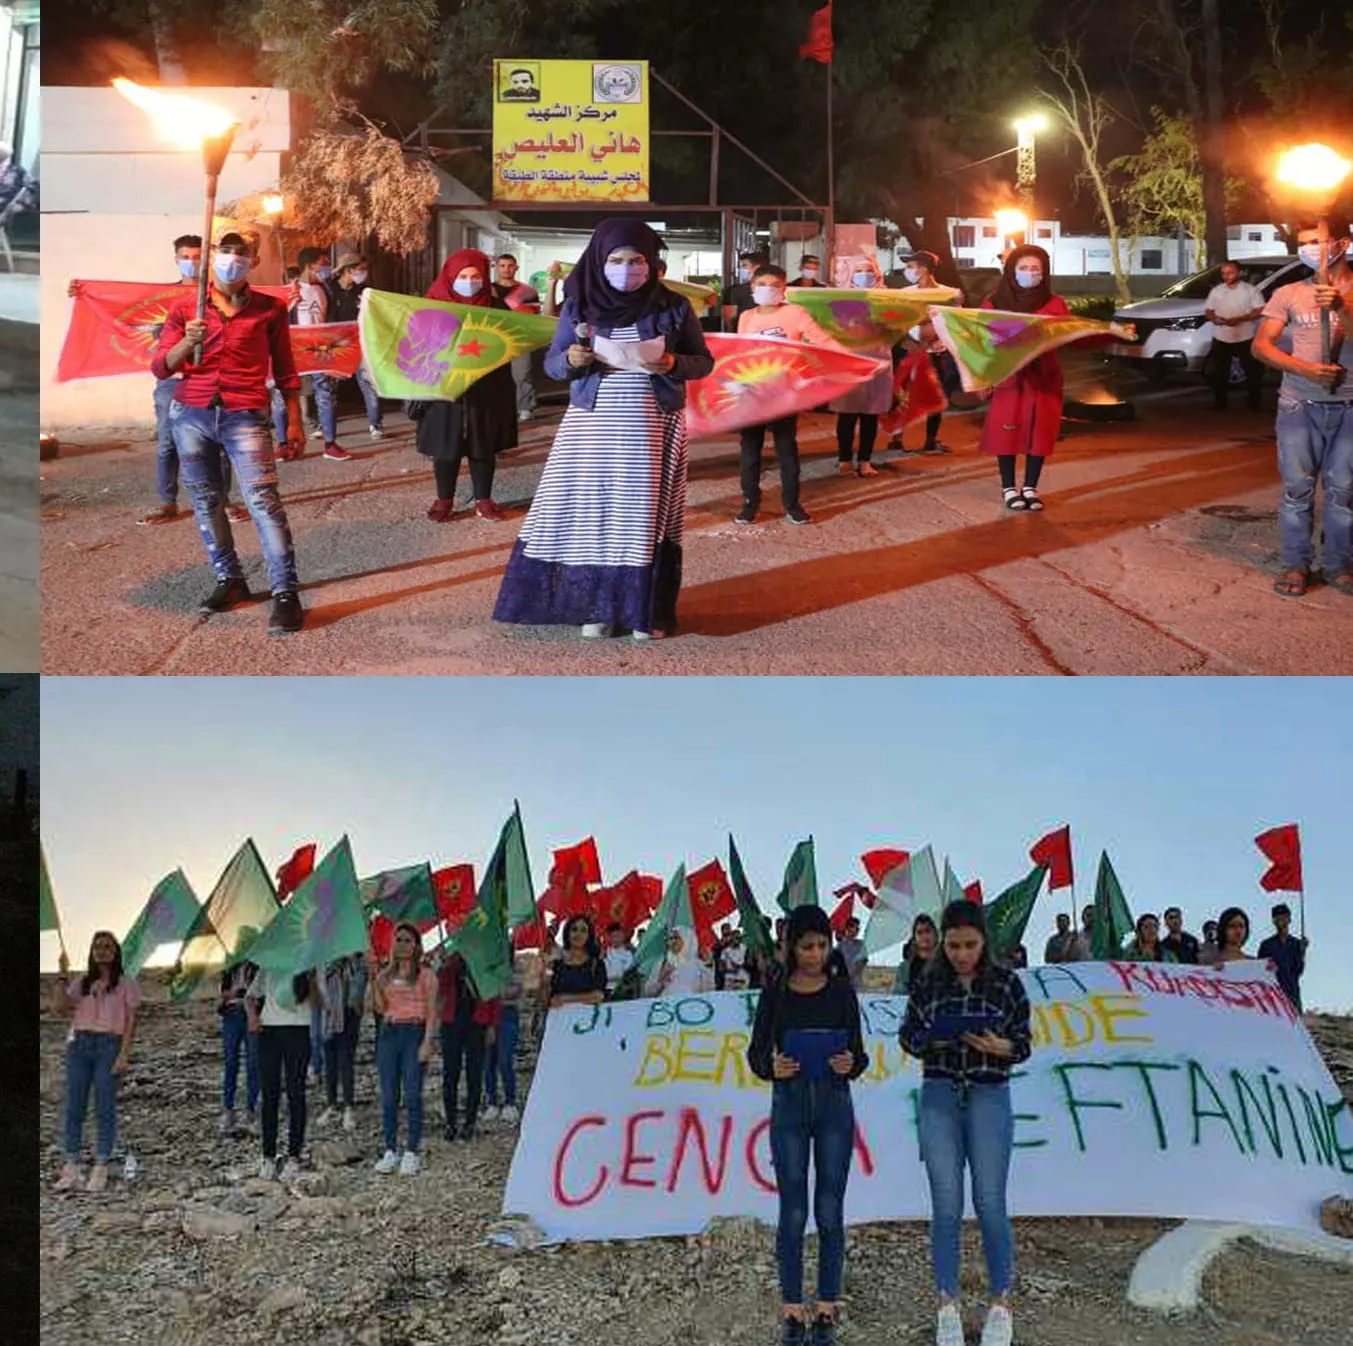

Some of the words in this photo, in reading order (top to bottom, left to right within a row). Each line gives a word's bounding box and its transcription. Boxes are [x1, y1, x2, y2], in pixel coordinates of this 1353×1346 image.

[526, 103, 572, 122] الشهيد
[575, 105, 617, 122] مركز
[590, 131, 641, 162] هاني
[647, 997, 715, 1028] BO
[634, 1028, 770, 1090] BER
